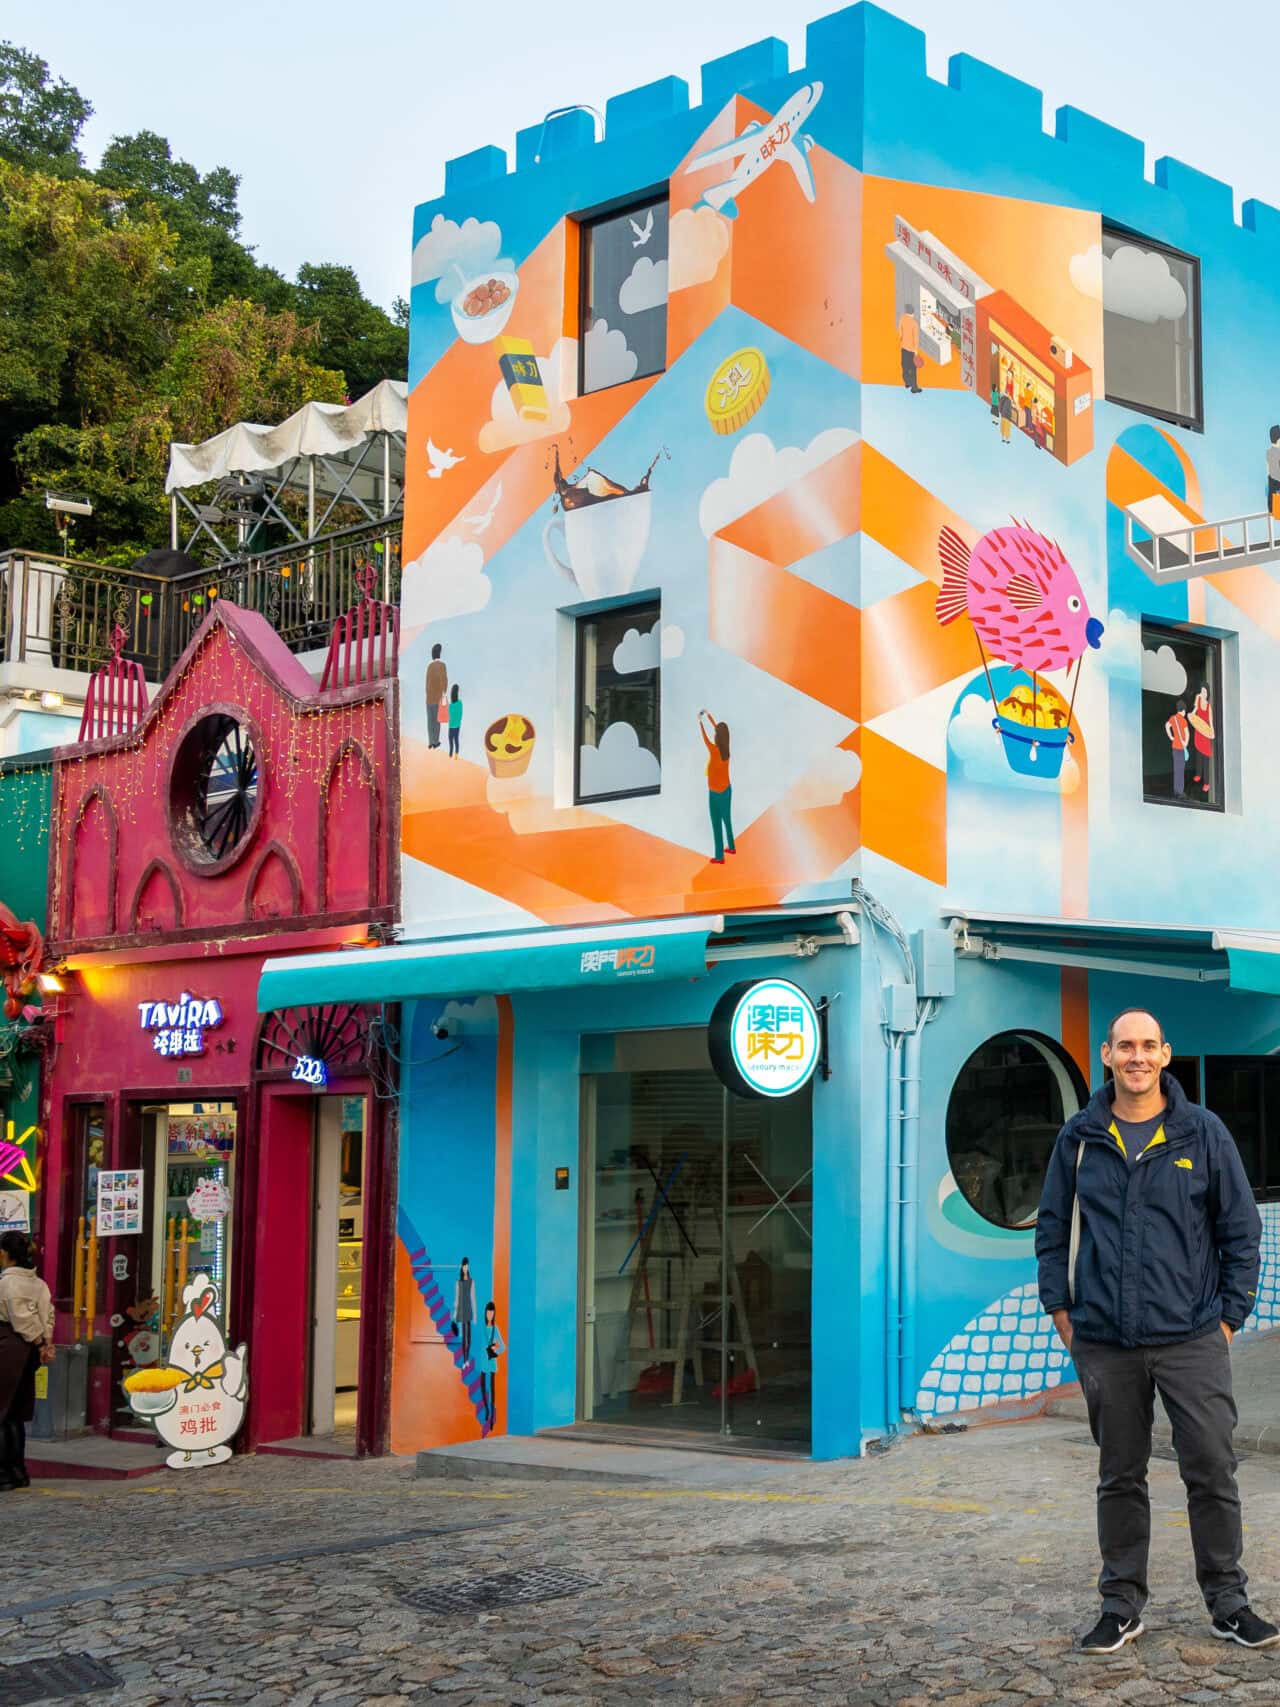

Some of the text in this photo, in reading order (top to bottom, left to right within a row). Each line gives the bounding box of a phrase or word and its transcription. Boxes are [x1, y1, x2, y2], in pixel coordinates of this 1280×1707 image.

[760, 121, 791, 160] 味力
[898, 223, 970, 299] 澳門味力
[580, 945, 656, 974] 澳門味力
[747, 1004, 804, 1032] 澳門
[180, 1416, 217, 1435] 鸡批
